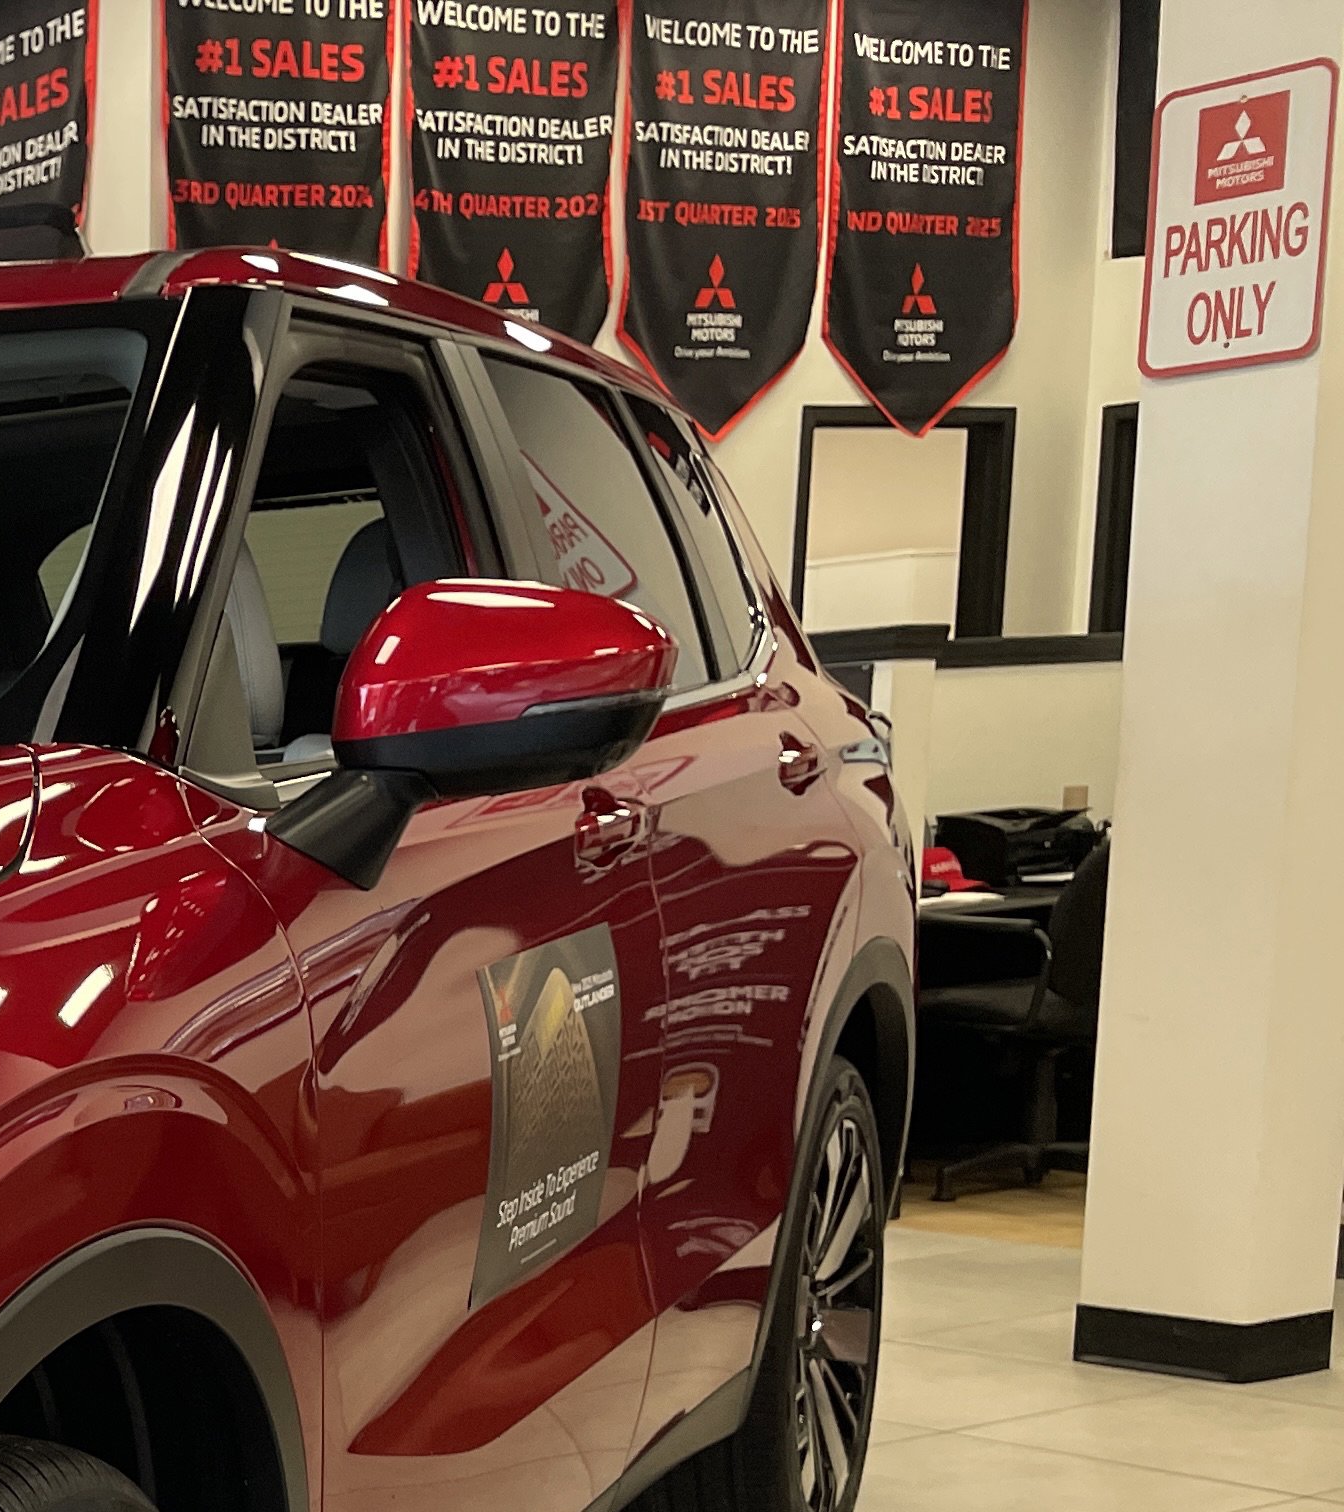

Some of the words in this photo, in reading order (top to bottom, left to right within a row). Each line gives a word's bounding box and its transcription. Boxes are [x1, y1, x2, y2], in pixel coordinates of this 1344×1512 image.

[18, 26, 45, 57] TO
[47, 8, 87, 47] THE
[416, 0, 527, 35] WELCOME
[531, 9, 561, 37] TO
[565, 12, 606, 39] THE
[644, 13, 743, 47] WELCOME
[746, 24, 776, 51] TO
[778, 27, 820, 55] THE
[196, 37, 243, 77] #1
[250, 38, 366, 83] SALES
[853, 32, 943, 66] WELCOME
[946, 43, 974, 67] TO
[977, 45, 1012, 71] THE
[432, 54, 480, 92] #1
[487, 56, 590, 99] SALES
[654, 68, 695, 105] #1
[703, 69, 797, 113] SALES
[172, 95, 307, 125] SATISFACTION
[310, 101, 384, 127] DEALER
[868, 86, 901, 120] #1
[908, 86, 994, 123] SALES
[201, 124, 224, 149] IN
[226, 125, 261, 150] THE
[263, 127, 357, 153] DISTRICT!
[537, 113, 613, 140] DEALER
[634, 120, 749, 148] SATISFACTION
[437, 138, 461, 160] IN
[465, 138, 496, 163] THE
[498, 142, 584, 165] DISTRICT!
[660, 149, 680, 170] IN
[682, 150, 713, 172] THE
[714, 153, 794, 176] DISTRICT!
[1207, 154, 1275, 179] MITSUBISHI
[870, 160, 888, 181] IN
[888, 162, 919, 183] THE
[1215, 170, 1265, 190] MOTORS
[173, 178, 220, 205] 3RD
[224, 181, 326, 211] QUARTER
[414, 187, 454, 216] 4TH
[458, 191, 551, 220] QUARTER
[553, 192, 601, 220] 202
[636, 198, 671, 223] 1ST
[674, 200, 759, 227] QUARTER
[847, 210, 883, 232] ND
[1162, 201, 1310, 279] PARKING
[1186, 280, 1277, 345] ONLY
[545, 1172, 557, 1199] To
